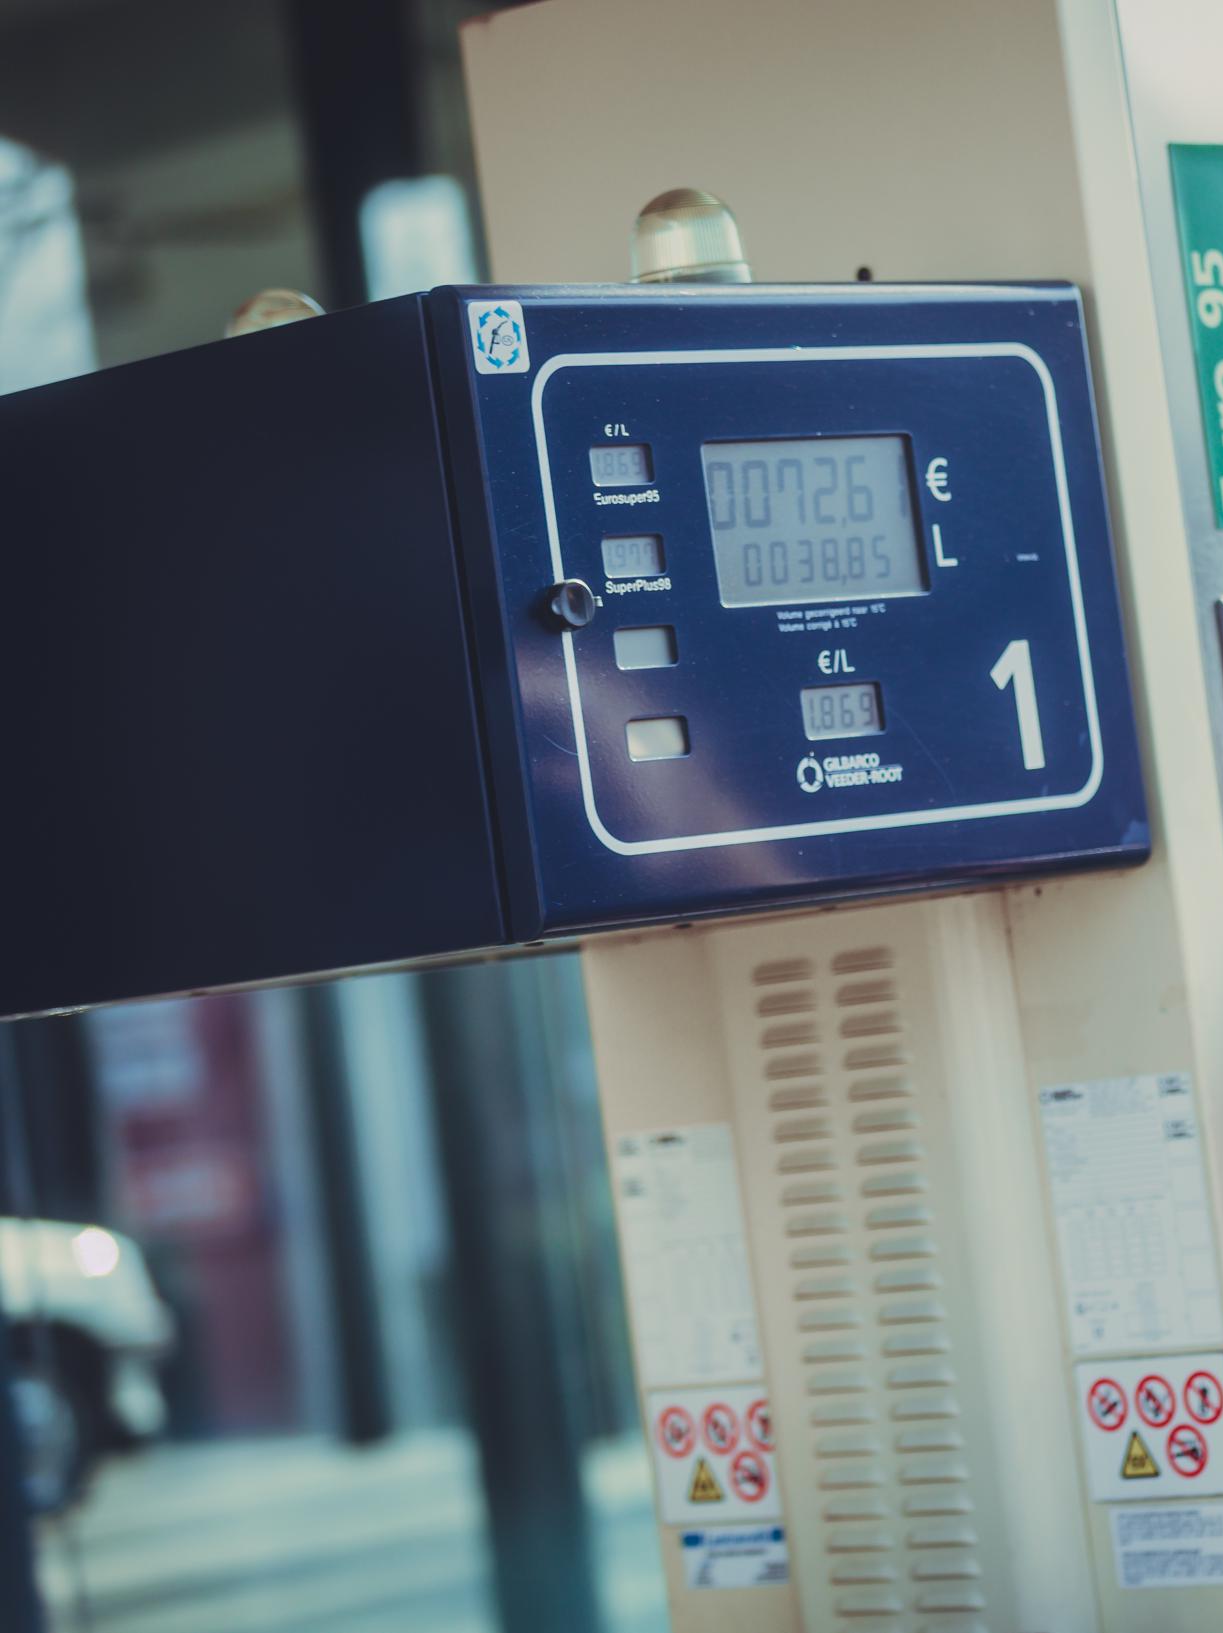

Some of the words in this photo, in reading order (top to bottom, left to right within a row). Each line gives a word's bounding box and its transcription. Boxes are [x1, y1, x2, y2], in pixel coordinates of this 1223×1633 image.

[604, 423, 630, 437] €/L
[926, 457, 952, 502] €
[593, 489, 660, 506] Eurosuper95
[932, 523, 958, 568] L
[743, 535, 891, 587] 0038,85
[605, 577, 672, 595] SuperPlus98
[818, 648, 856, 674] €/L
[809, 692, 874, 734] 1,869
[989, 639, 1046, 770] 1
[822, 752, 880, 772] GILBARCO
[825, 766, 903, 788] VEEDER-ROOT
